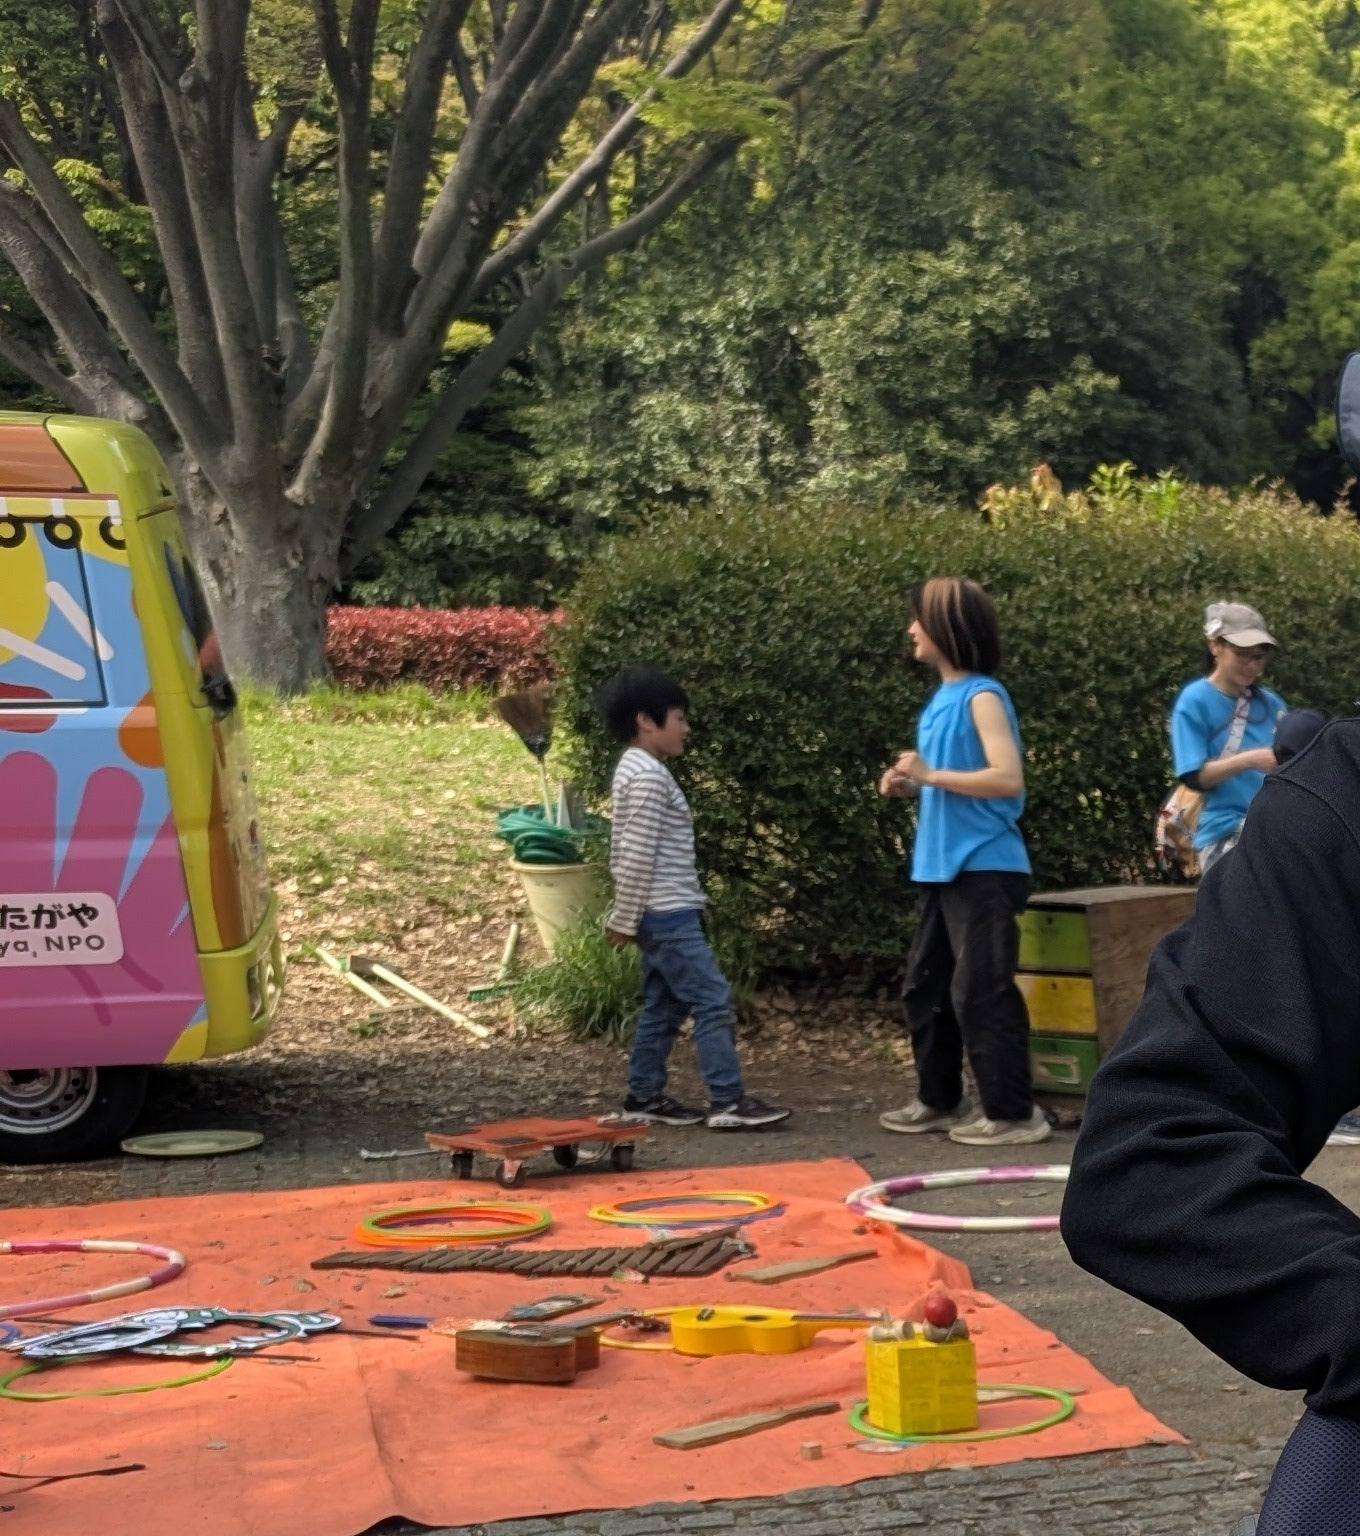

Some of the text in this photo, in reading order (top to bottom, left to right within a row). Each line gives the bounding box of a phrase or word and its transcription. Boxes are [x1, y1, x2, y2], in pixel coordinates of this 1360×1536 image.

[0, 903, 100, 930] たがや
[44, 934, 105, 951] NPO
